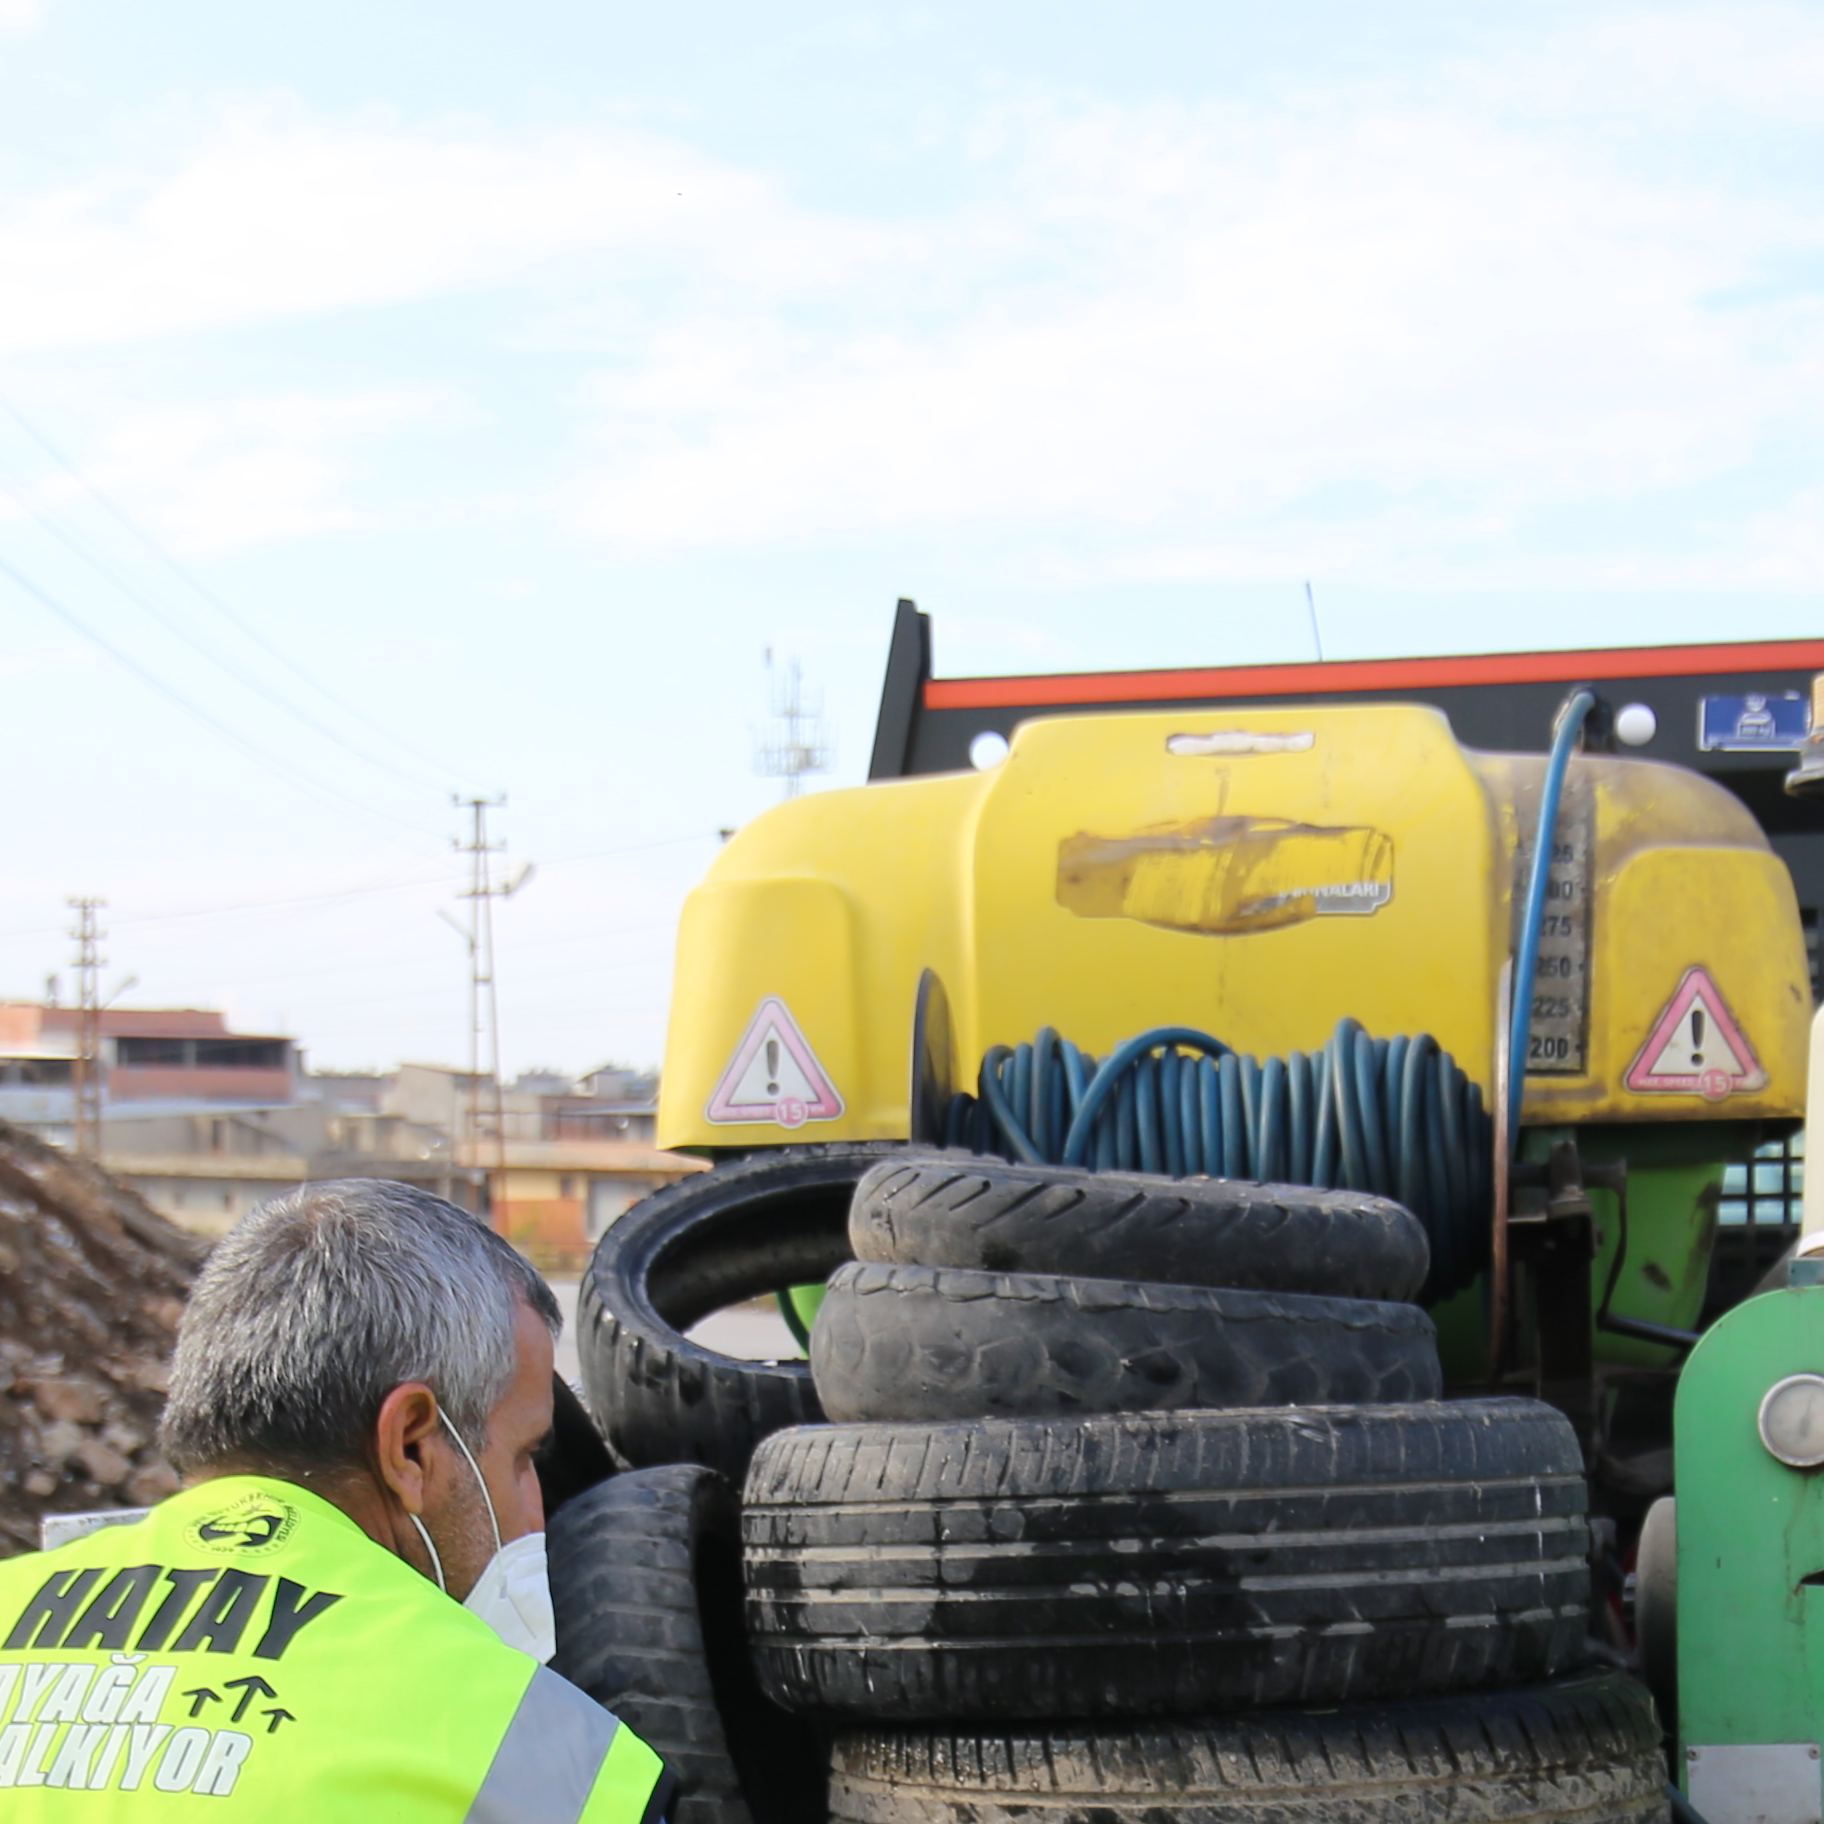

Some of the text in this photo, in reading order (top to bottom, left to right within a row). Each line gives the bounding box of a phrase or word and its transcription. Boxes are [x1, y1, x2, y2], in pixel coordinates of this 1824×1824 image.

[1532, 997, 1570, 1020] 225
[1529, 1036, 1570, 1061] 200
[1702, 1075, 1726, 1093] 15
[779, 1102, 804, 1120] 15
[0, 1564, 347, 1661] HATAY
